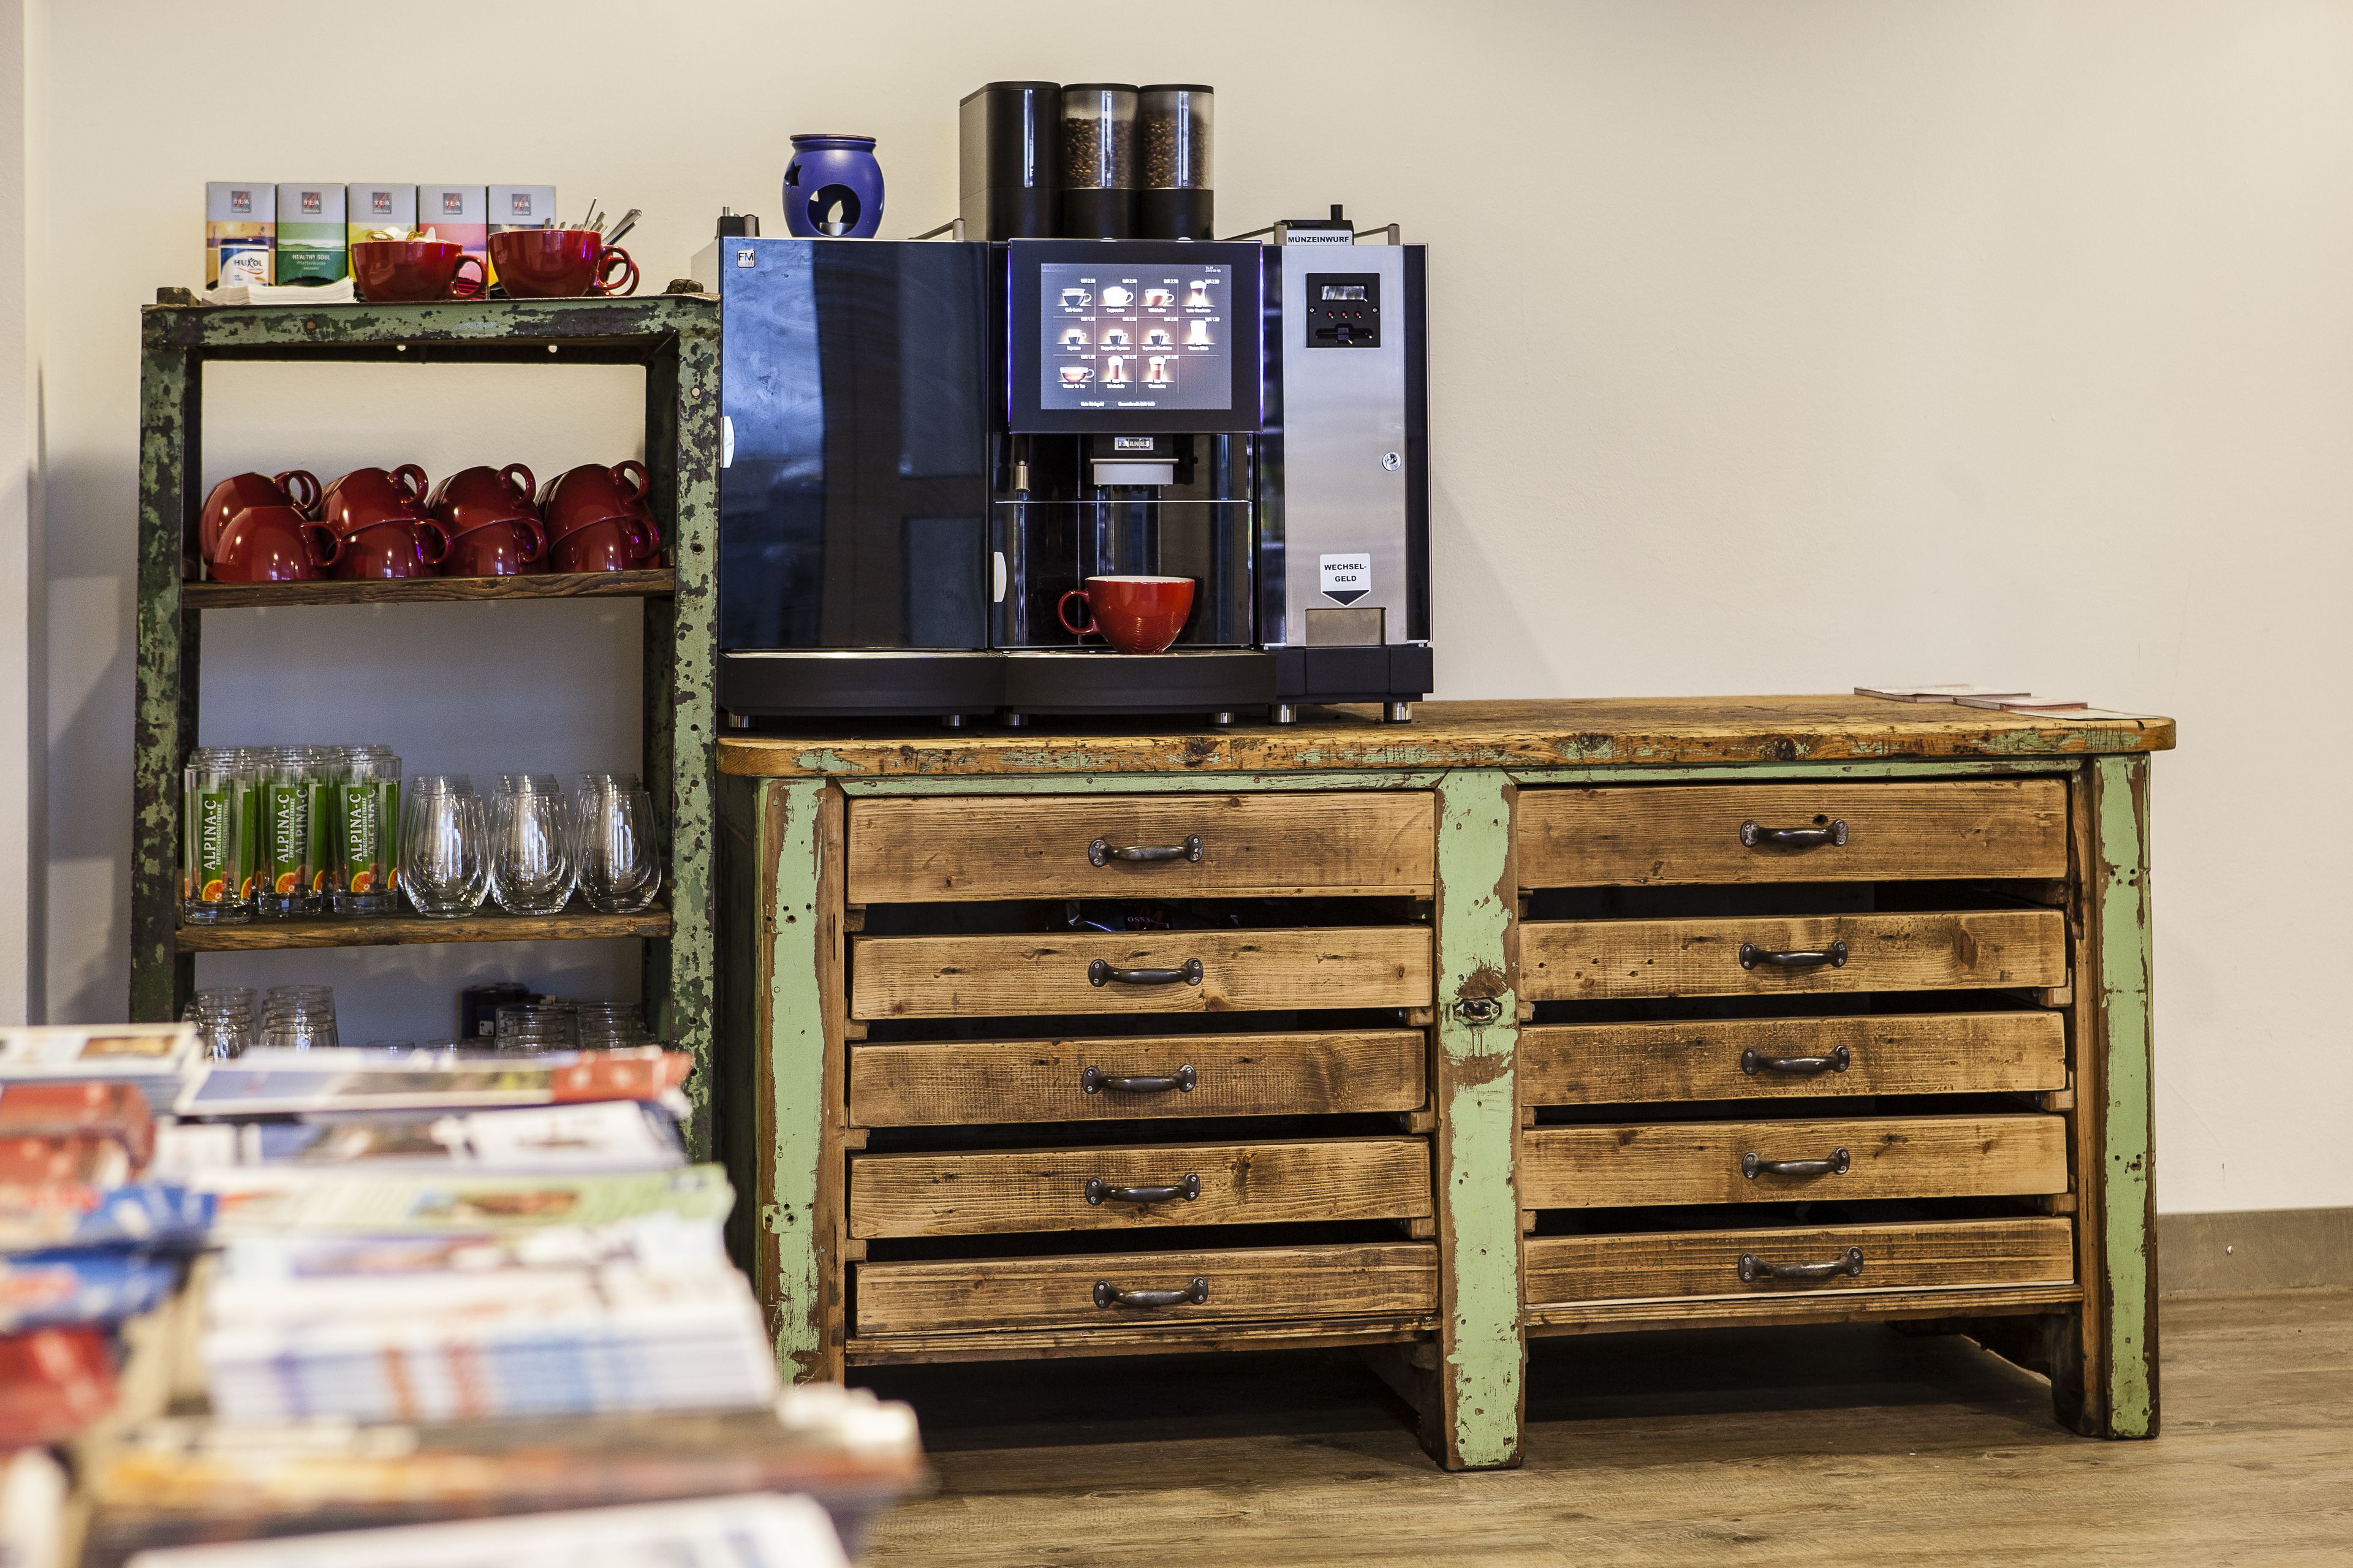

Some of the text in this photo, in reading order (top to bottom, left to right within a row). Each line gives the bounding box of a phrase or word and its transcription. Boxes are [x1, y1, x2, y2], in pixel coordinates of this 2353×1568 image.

[234, 257, 263, 268] HUXOL
[203, 800, 217, 870] ALPINA-C
[277, 794, 290, 863] ALPINA-C
[295, 789, 308, 854] ALPINA-C
[349, 793, 363, 862] ALPINA-C
